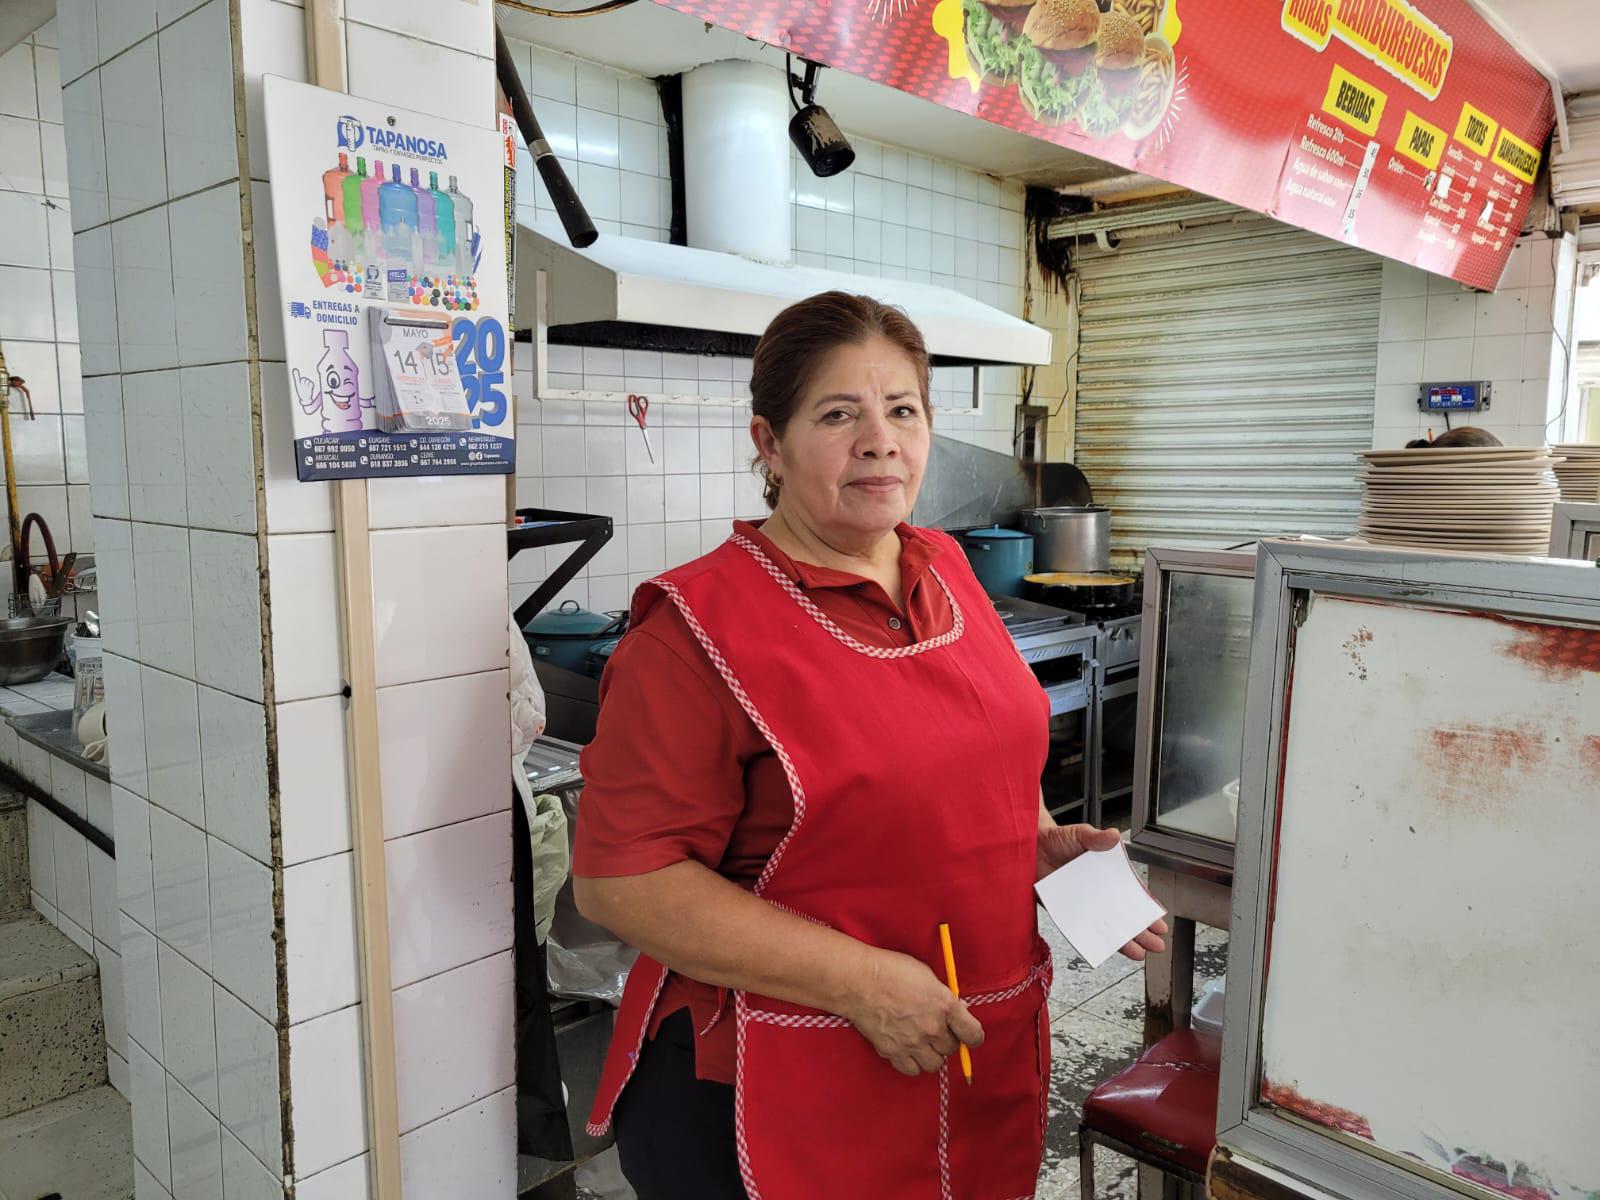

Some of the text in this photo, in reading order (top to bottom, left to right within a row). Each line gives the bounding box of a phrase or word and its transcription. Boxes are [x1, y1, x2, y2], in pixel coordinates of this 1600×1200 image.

[1337, 0, 1448, 89] HAMBURGUESAS
[1335, 79, 1375, 124] BEBIDAS
[366, 125, 448, 160] TAPANOSA
[1307, 113, 1334, 139] Refresco
[1409, 125, 1435, 159] PAPAS
[1464, 114, 1488, 147] TORTAS
[1300, 135, 1327, 159] Refresco
[1497, 136, 1538, 177] HAMBURGUESAS
[312, 300, 360, 313] ENTREGAS A
[316, 313, 358, 325] DOMICILIO
[403, 327, 429, 339] MAYO
[452, 316, 505, 374] 20
[394, 349, 450, 376] 14 15
